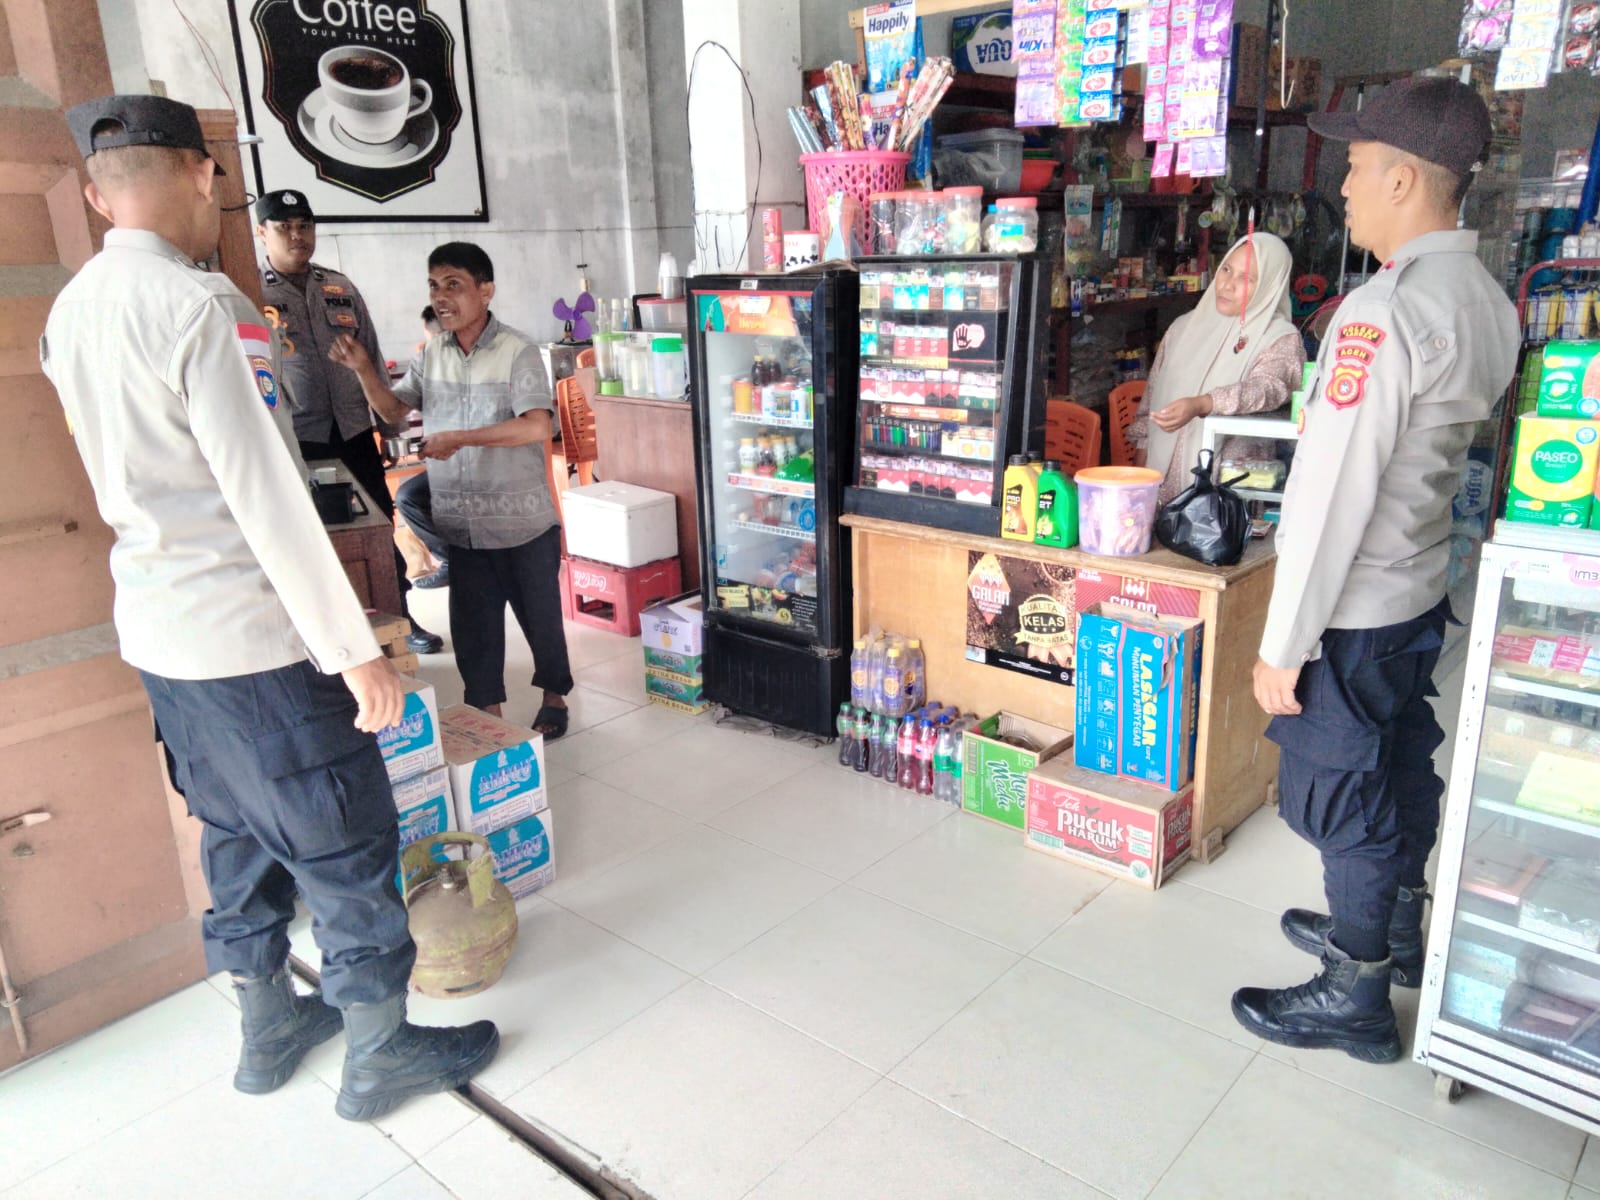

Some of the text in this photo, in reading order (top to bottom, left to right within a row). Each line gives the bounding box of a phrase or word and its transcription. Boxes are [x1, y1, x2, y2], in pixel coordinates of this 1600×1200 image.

[293, 0, 416, 34] Coffee
[868, 11, 910, 34] Happily
[302, 27, 417, 47] YOUR TEXT HERE
[976, 37, 1012, 64] QUA
[1535, 451, 1579, 463] PASEO
[1023, 616, 1065, 627] KELAS
[1131, 646, 1142, 747] MINUMAN PENYEGAR
[987, 761, 1015, 808] Madu
[1068, 825, 1117, 849] HARUM
